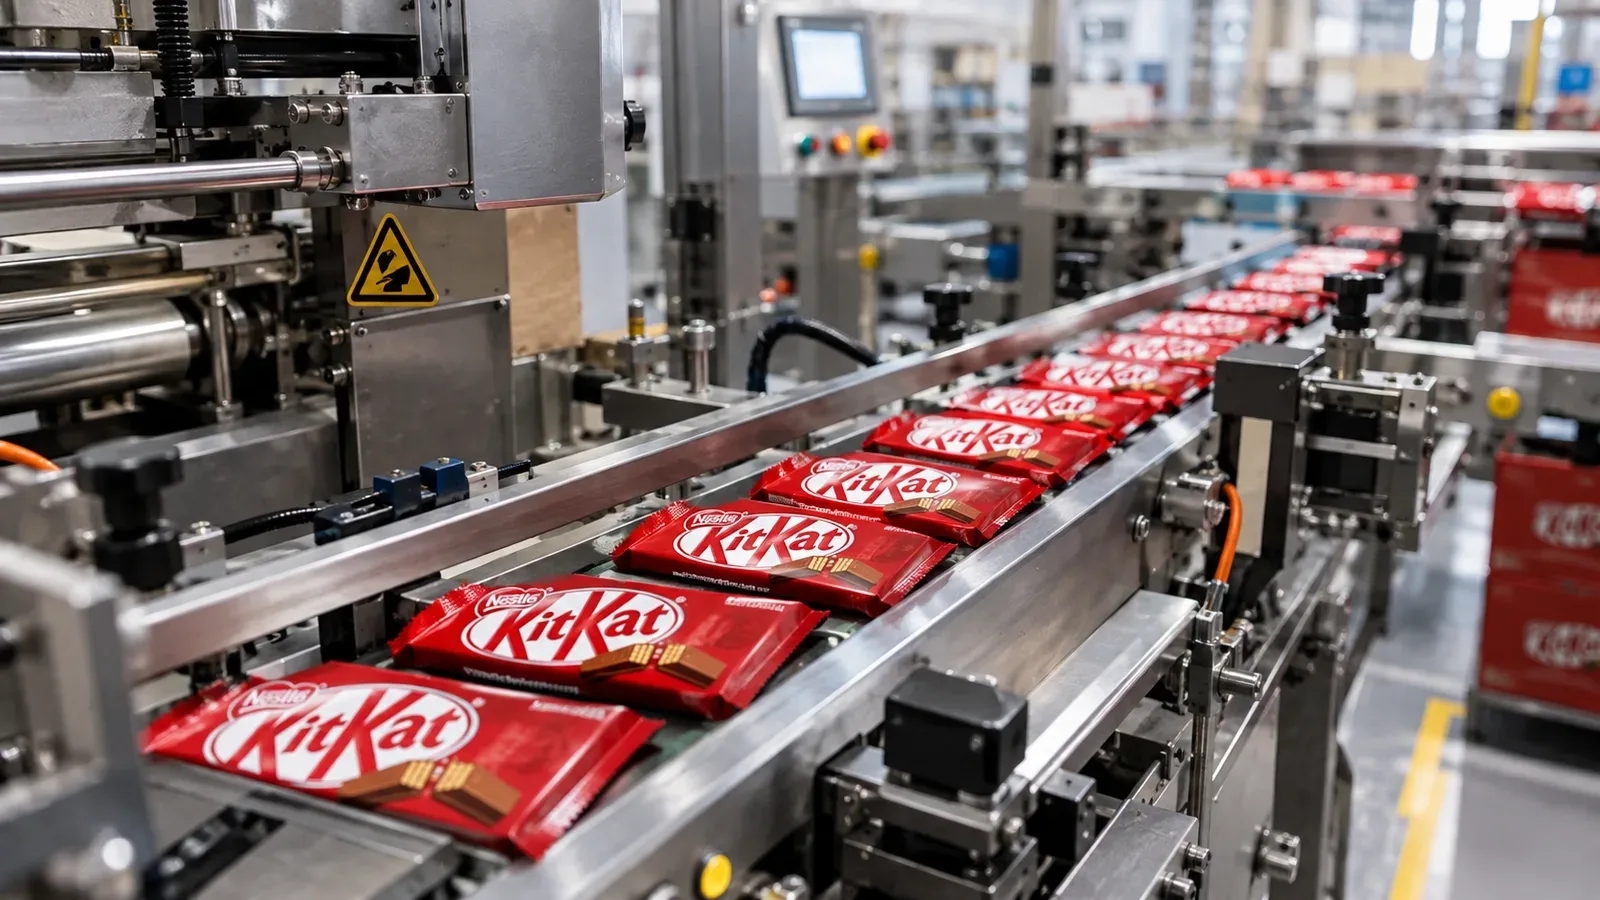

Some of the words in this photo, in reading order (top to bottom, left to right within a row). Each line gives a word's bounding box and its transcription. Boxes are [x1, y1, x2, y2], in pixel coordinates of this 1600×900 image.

[992, 390, 1085, 417] KitKat
[920, 422, 1033, 454] KitKat
[816, 464, 947, 505] KitKat
[689, 515, 843, 568] KitKat
[481, 589, 669, 661] KitKat
[224, 687, 461, 781] KitKat
